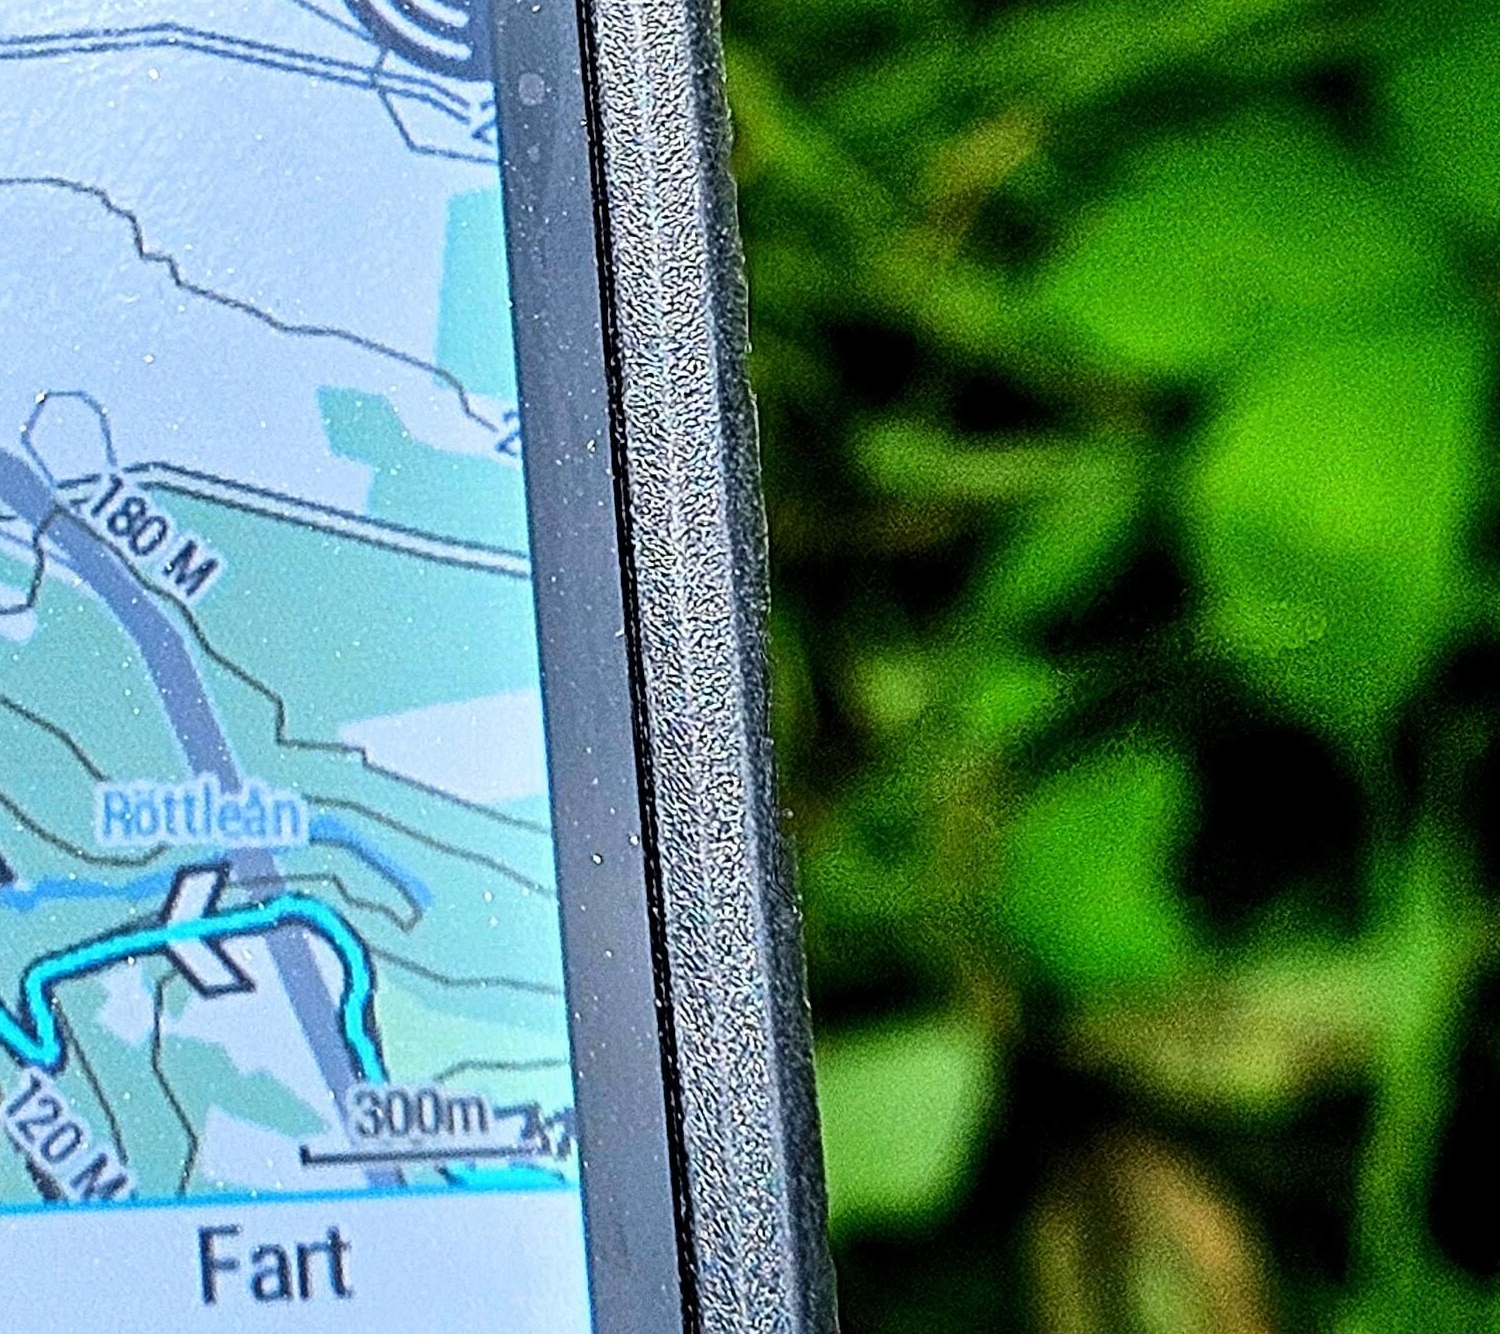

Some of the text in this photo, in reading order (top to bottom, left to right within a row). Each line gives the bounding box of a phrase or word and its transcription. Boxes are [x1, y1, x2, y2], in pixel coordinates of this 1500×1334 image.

[91, 473, 219, 597] 180 M
[103, 781, 301, 839] Röttleån
[5, 1074, 128, 1199] 120 M
[354, 1087, 489, 1137] 300m
[199, 1224, 353, 1305] Fart
